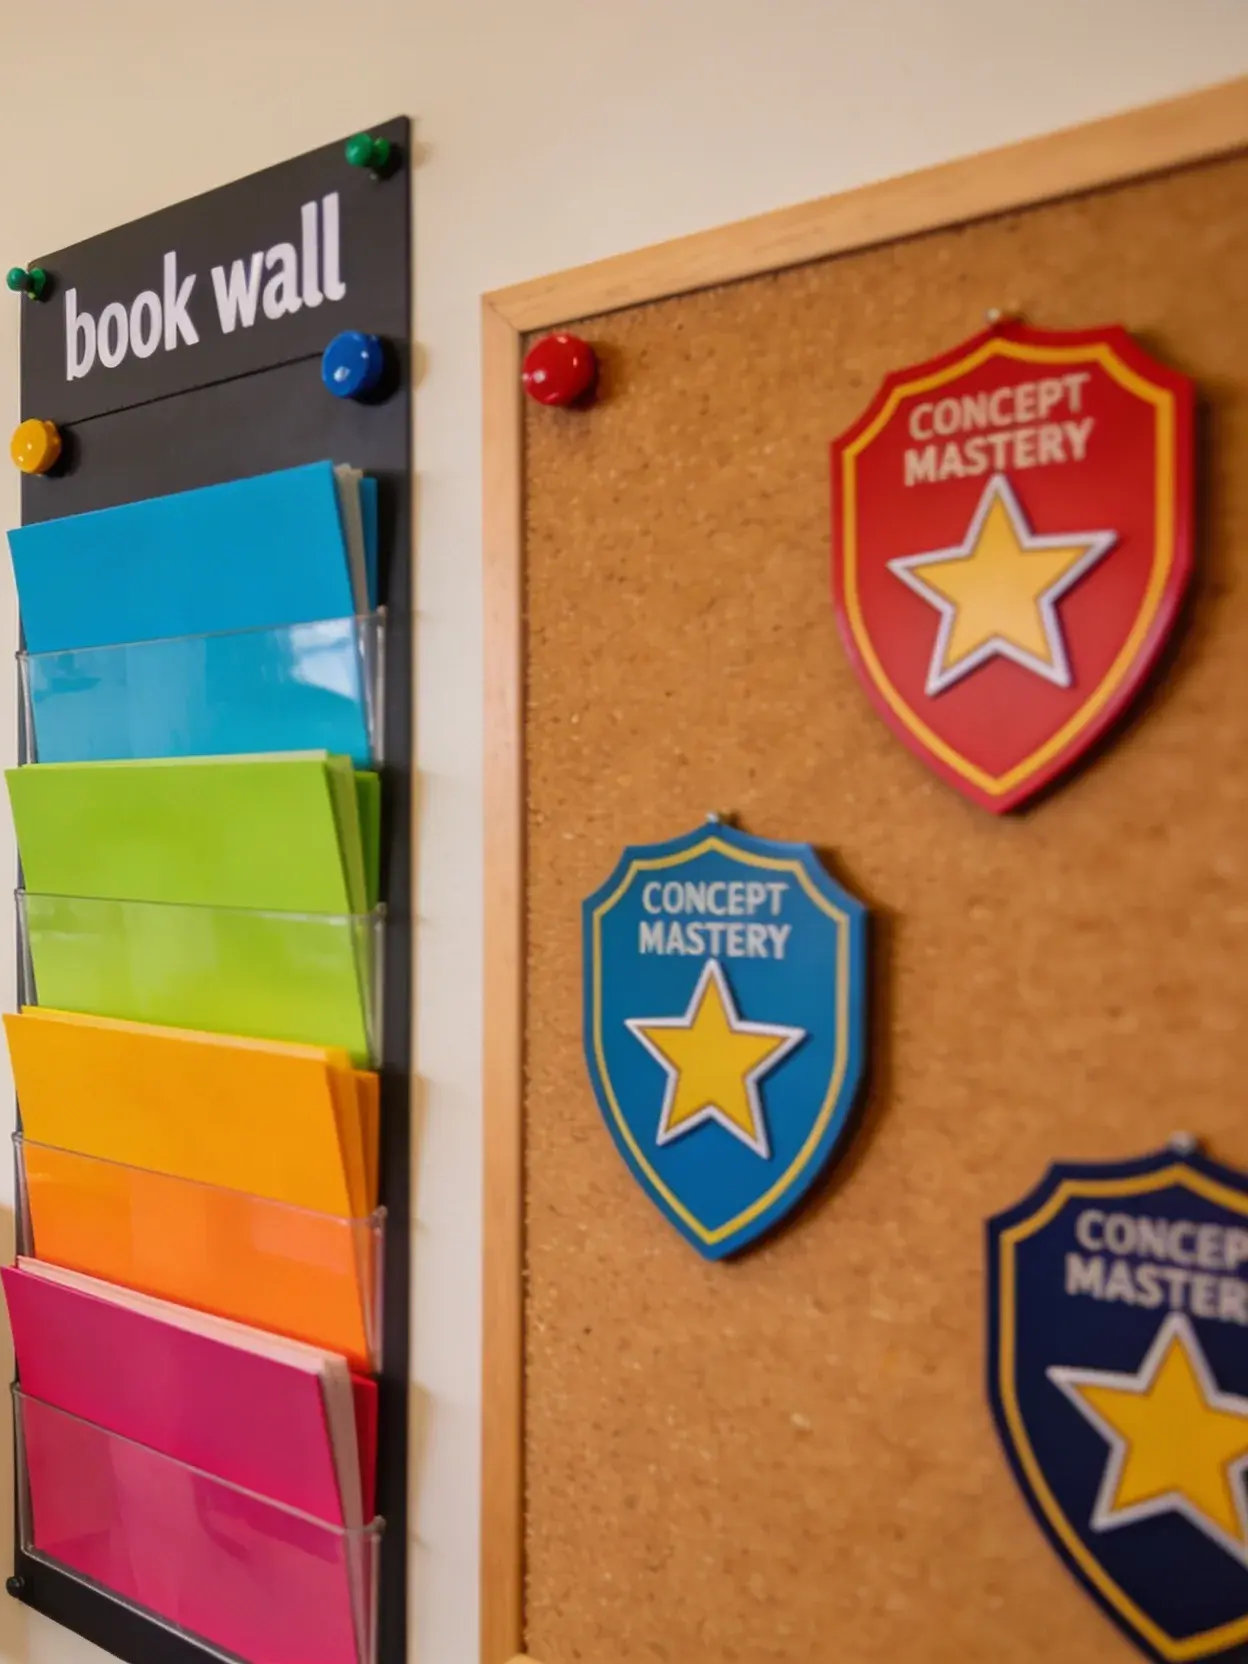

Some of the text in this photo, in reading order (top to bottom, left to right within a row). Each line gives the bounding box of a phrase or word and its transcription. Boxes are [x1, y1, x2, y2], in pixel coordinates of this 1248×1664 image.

[65, 192, 346, 382] book wall
[908, 372, 1089, 441] CONCEPT
[903, 417, 1094, 487] MASTERY
[641, 881, 789, 916] CONCEPT
[638, 920, 792, 960] MASTERY
